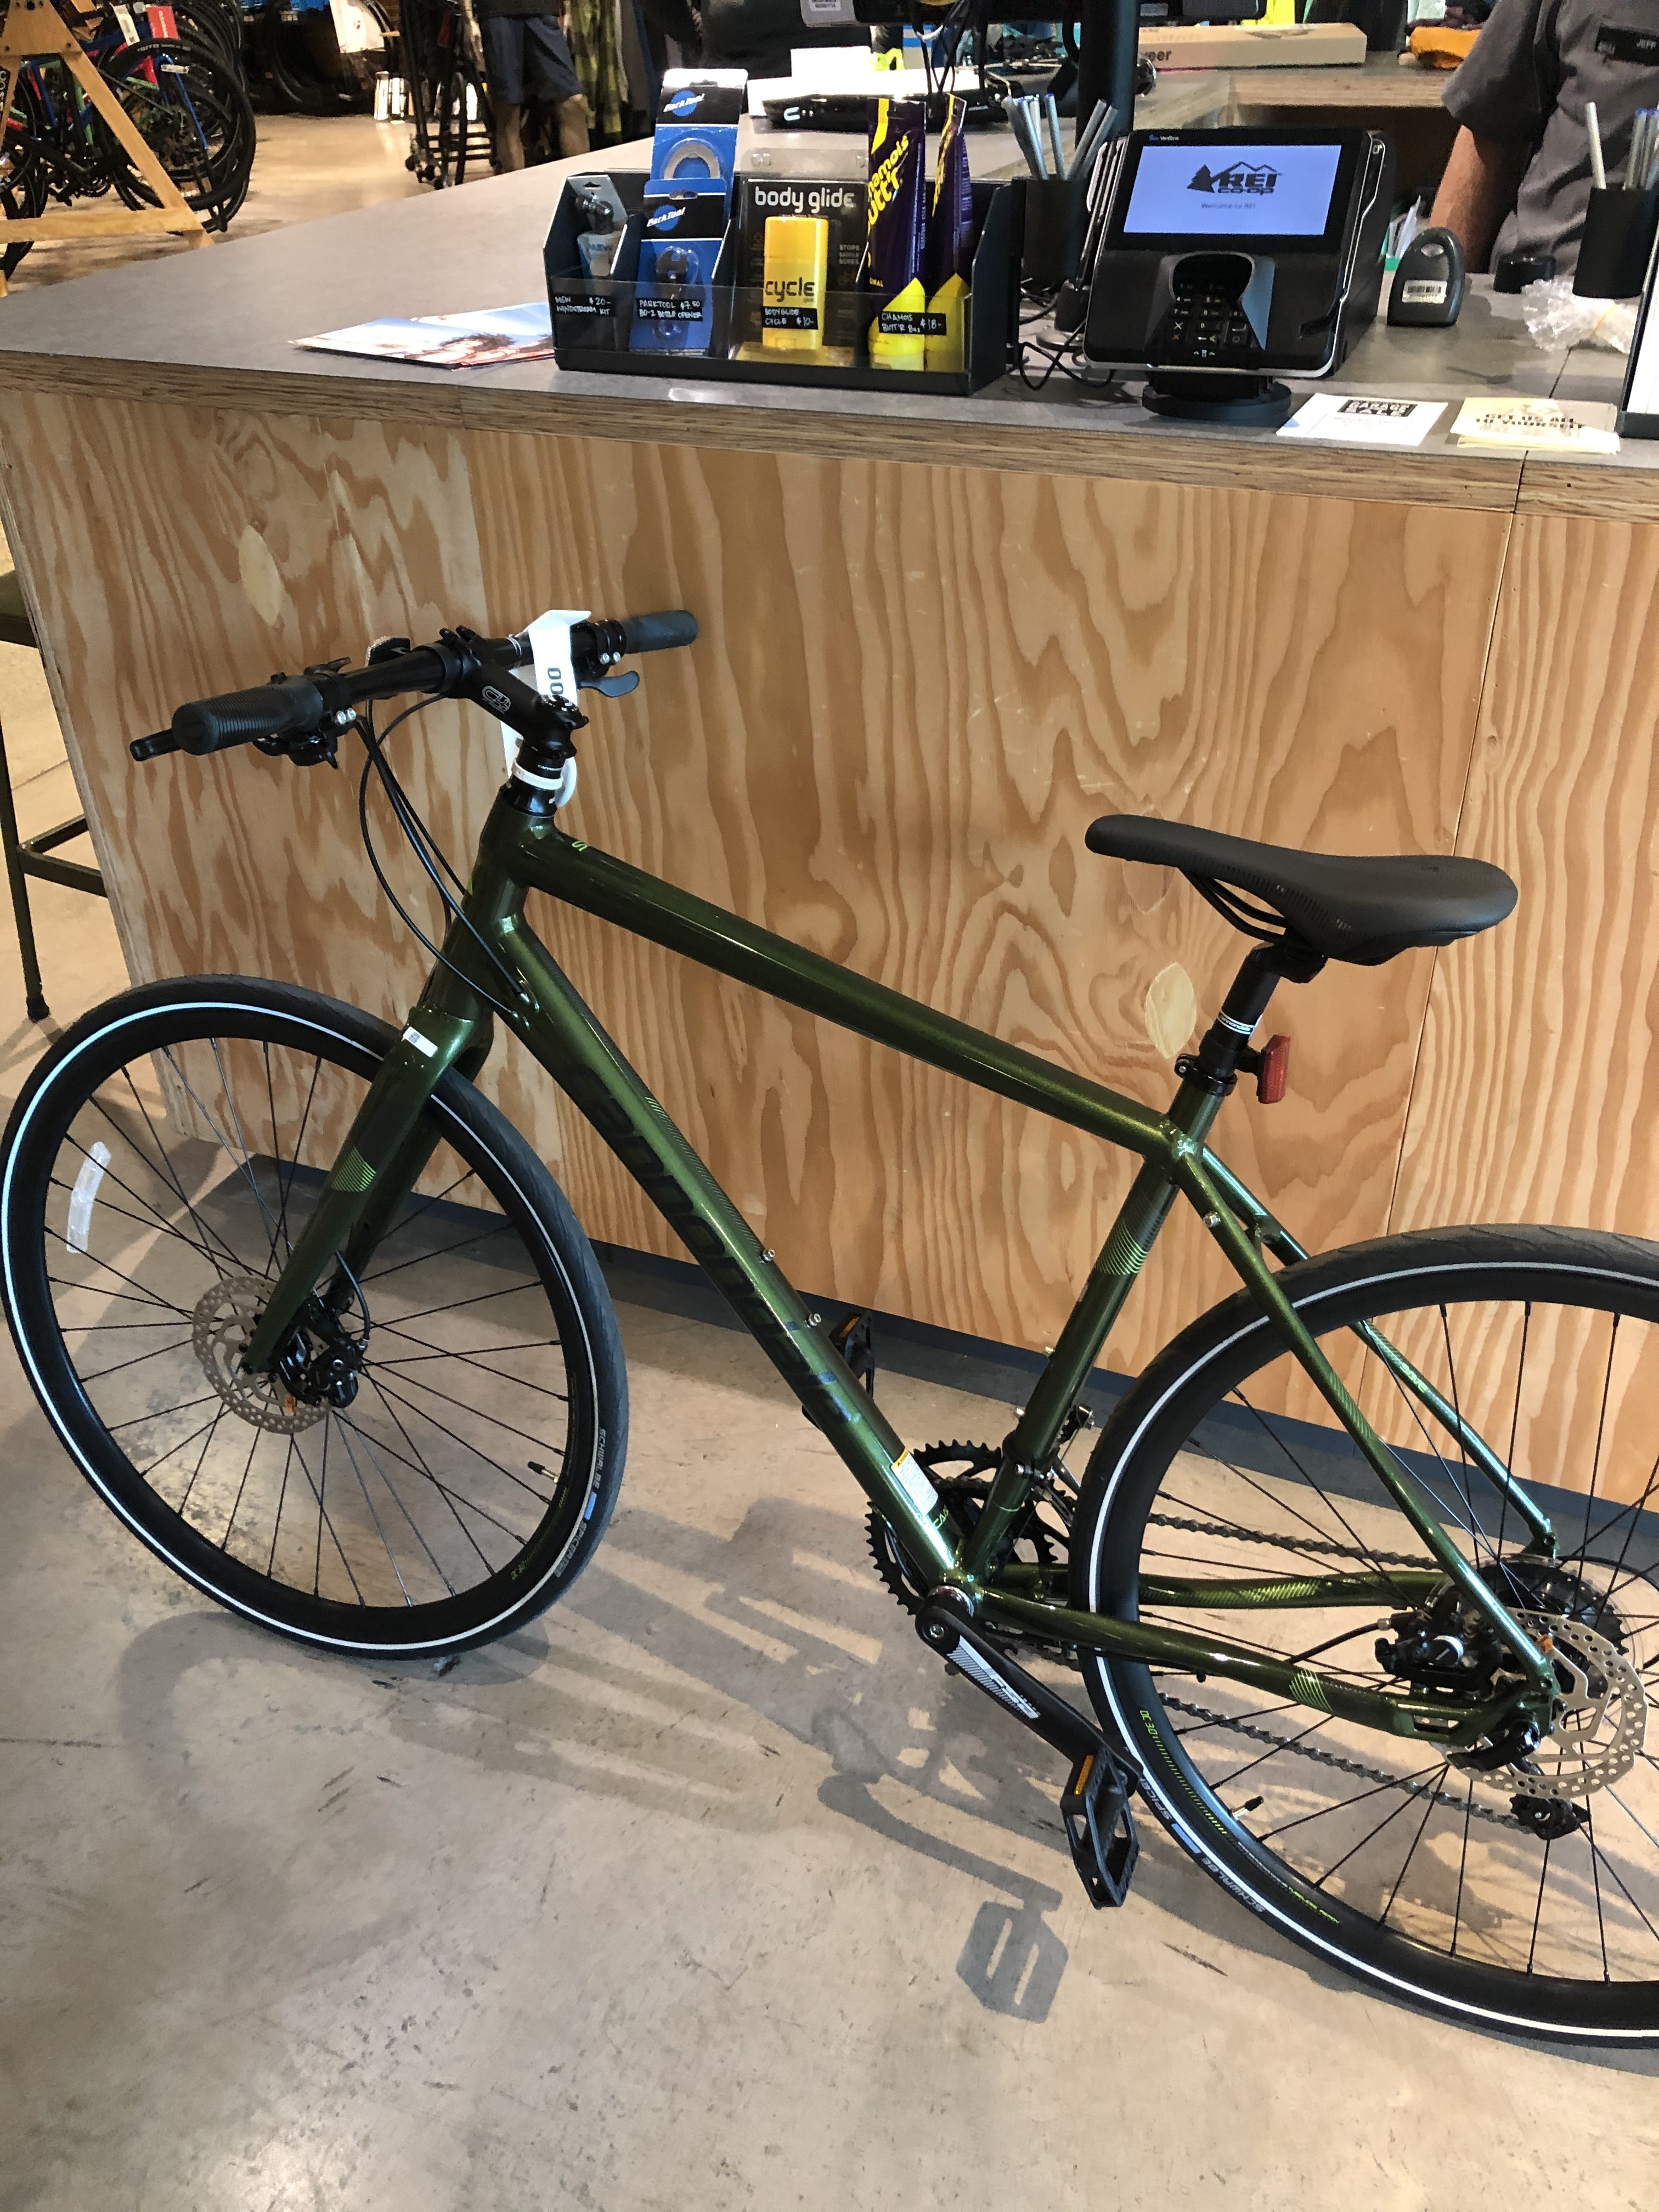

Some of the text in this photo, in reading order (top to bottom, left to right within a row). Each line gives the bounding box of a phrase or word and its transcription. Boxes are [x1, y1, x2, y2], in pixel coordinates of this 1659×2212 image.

[755, 185, 855, 213] body glide
[1219, 173, 1278, 187] REI
[765, 276, 815, 302] cycle
[564, 1059, 864, 1425] cannondale
[593, 1428, 606, 1489] SCHWALBE
[1201, 1857, 1266, 1913] SCHWALBE
